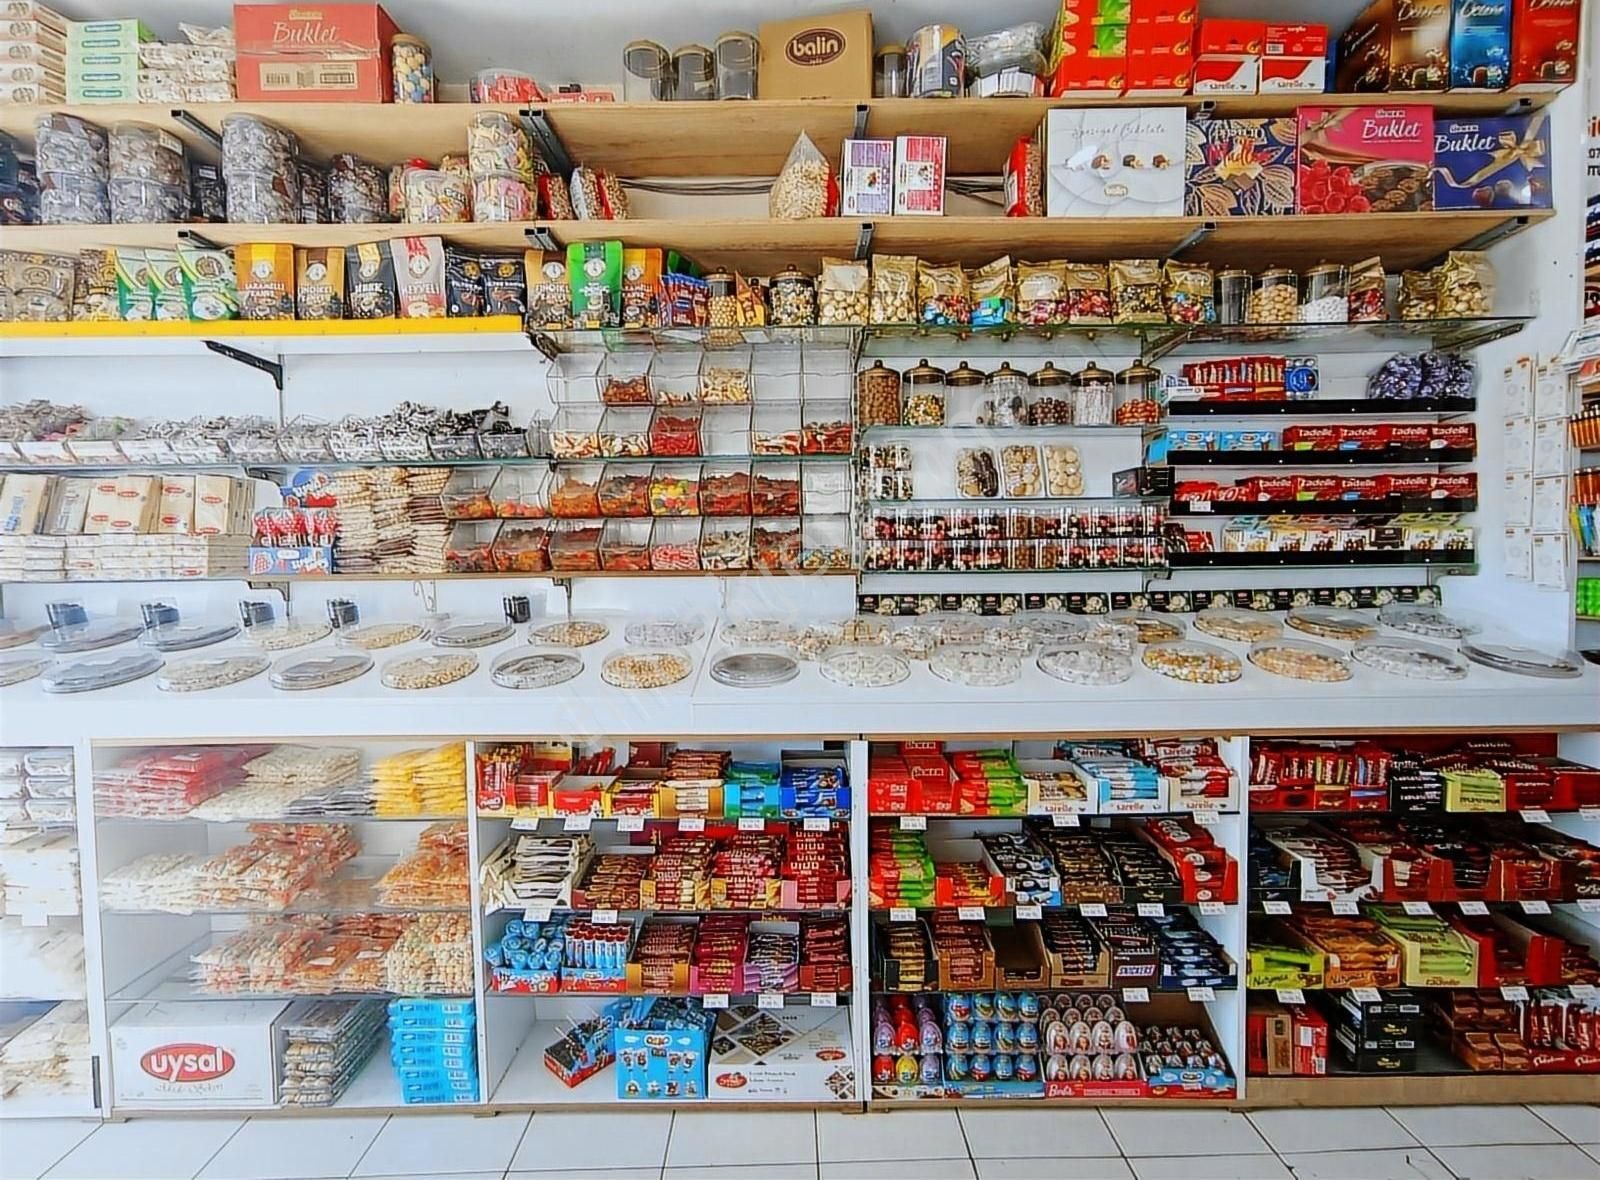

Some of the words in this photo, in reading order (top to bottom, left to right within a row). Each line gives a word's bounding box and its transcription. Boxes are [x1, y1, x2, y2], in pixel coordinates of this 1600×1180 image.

[273, 21, 336, 44] Buklet
[793, 36, 838, 57] balin
[1362, 119, 1422, 139] Buklet
[1435, 134, 1496, 153] Buklet
[1299, 428, 1332, 436] tadelle
[1119, 966, 1154, 975] SNICKERS
[150, 1046, 224, 1083] uysal
